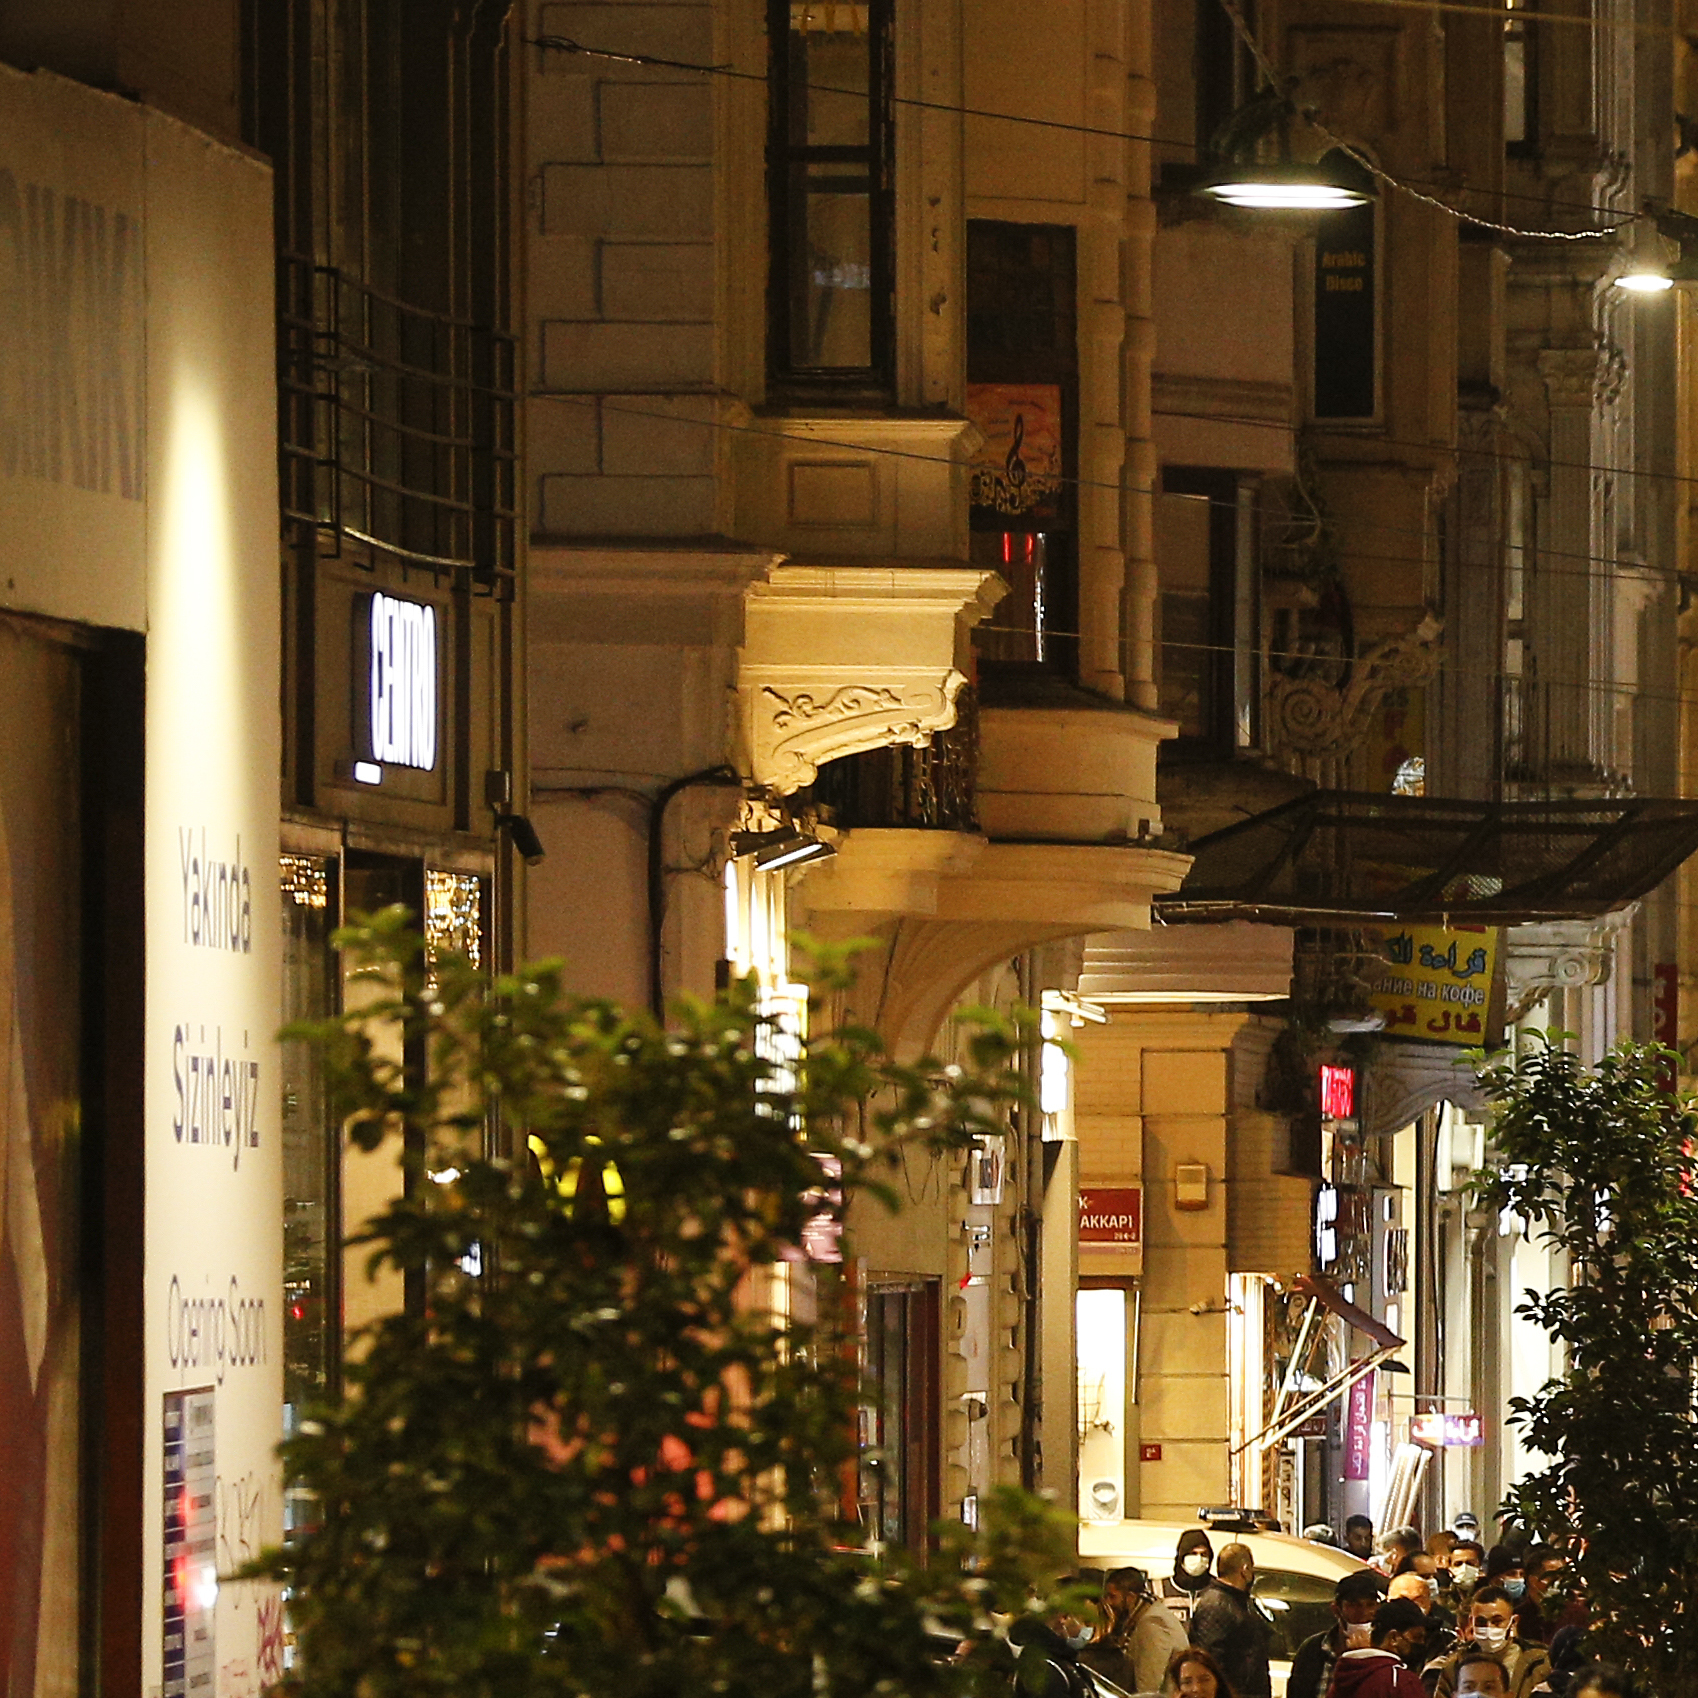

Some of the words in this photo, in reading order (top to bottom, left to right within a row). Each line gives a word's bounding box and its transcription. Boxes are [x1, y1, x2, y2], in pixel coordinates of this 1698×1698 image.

[370, 591, 437, 771] CENTRO
[179, 826, 250, 954] Yakında
[1416, 980, 1437, 999] на
[1441, 981, 1485, 1009] кофе
[173, 1022, 260, 1173] Sizinleyiz
[1080, 1214, 1133, 1229] AKKAPI
[167, 1273, 226, 1386] Opening
[229, 1275, 268, 1368] Soon
